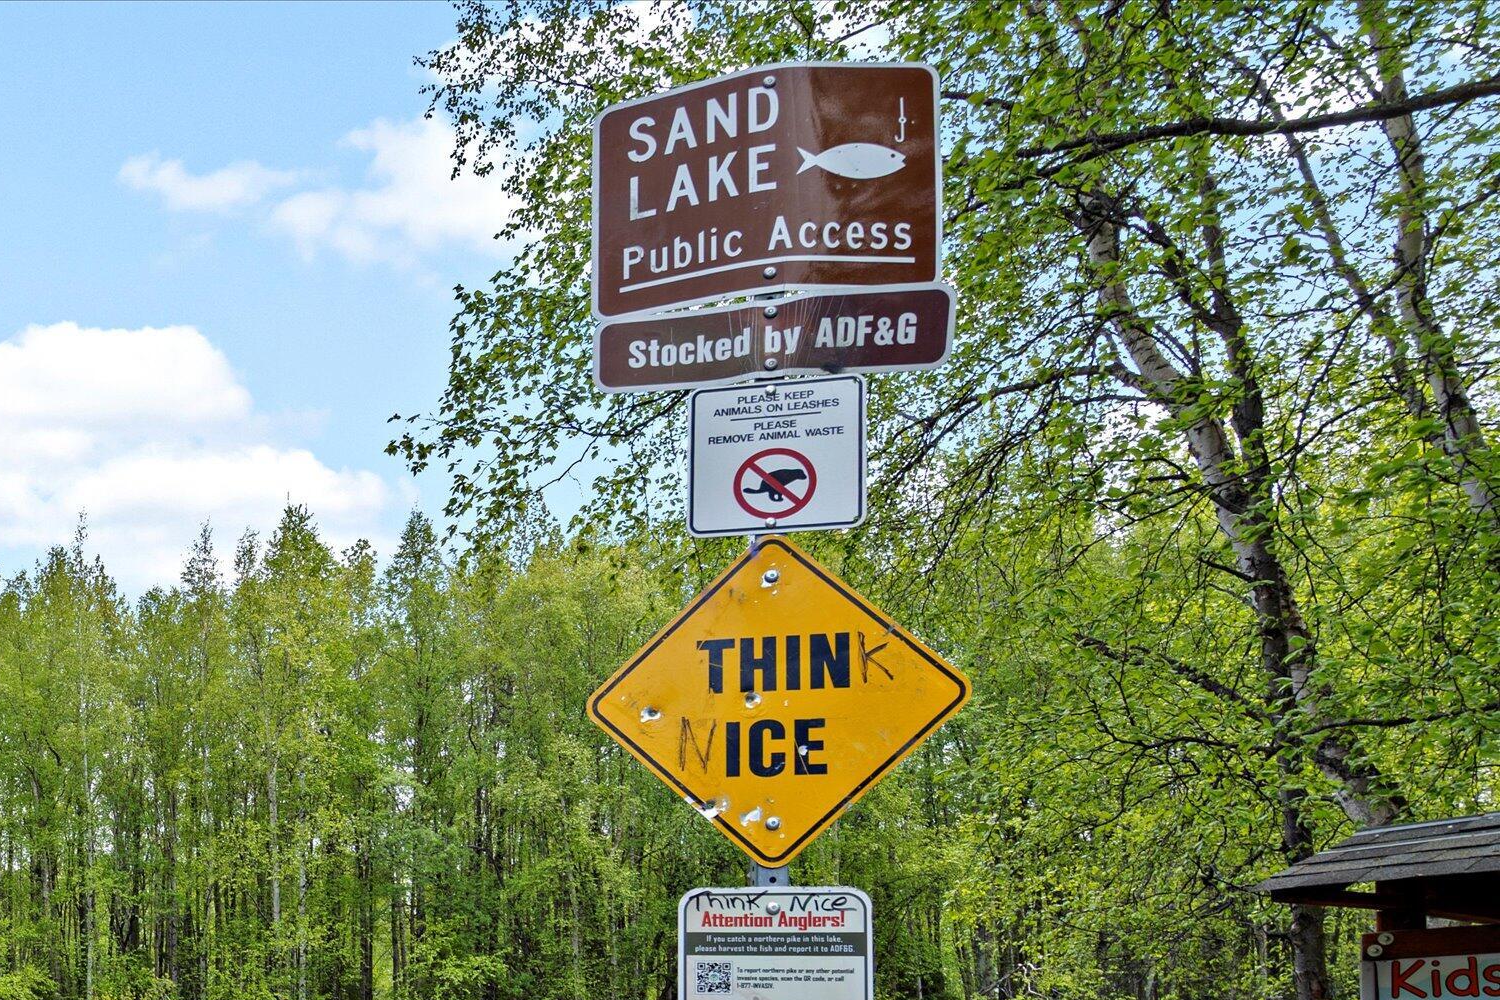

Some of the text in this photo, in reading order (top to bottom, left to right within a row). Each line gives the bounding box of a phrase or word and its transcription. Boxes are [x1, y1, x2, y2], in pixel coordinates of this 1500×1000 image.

[627, 86, 780, 163] SAND
[629, 144, 778, 221] LAKE
[623, 215, 913, 280] Public Access
[628, 312, 918, 369] Stocked by ADF&G
[737, 390, 814, 404] PLEASE KEEP
[713, 398, 840, 417] ANIMALS ON LEASHES
[708, 425, 844, 445] REMOVE ANIMAL WASTE
[753, 419, 797, 431] PLEASE
[688, 890, 857, 912] Think Nice
[701, 910, 845, 930] Attention Anglers!
[695, 945, 717, 953] please
[788, 945, 812, 953] report
[786, 935, 801, 943] pike
[1391, 956, 1500, 999] Kids
